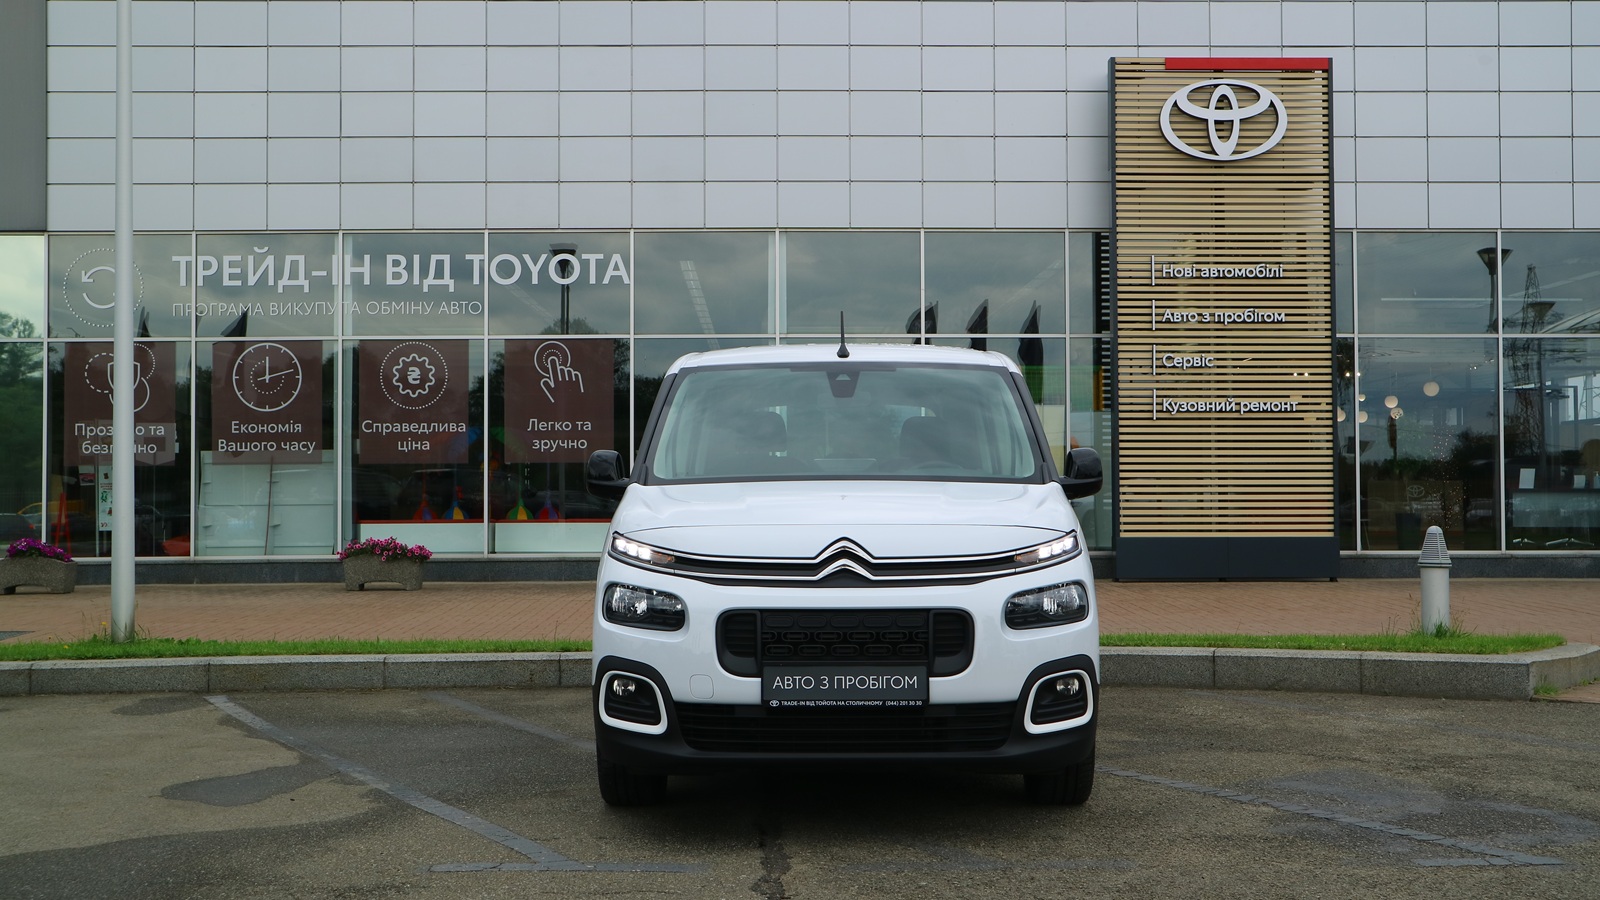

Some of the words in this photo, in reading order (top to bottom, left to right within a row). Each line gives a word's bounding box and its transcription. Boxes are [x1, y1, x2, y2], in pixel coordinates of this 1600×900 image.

[172, 246, 371, 293] ТРЕЙД-ІН
[386, 254, 455, 293] ВІД
[465, 253, 630, 285] TOYOTA
[1162, 264, 1196, 278] Нові
[1200, 264, 1284, 278] автомобілі
[172, 302, 264, 317] ПРОГРАМА
[270, 301, 338, 316] ВИКУПУ
[366, 301, 435, 315] ОБМІНУ
[438, 301, 482, 315] АВТО
[1162, 309, 1198, 323] Авто
[1201, 312, 1210, 323] з
[1214, 308, 1286, 326] пробігом
[1162, 354, 1214, 370] Сервіс
[1162, 398, 1236, 415] Кузовний
[1240, 400, 1299, 415] ремонт
[74, 423, 145, 439] Прозо
[148, 425, 165, 436] та
[231, 420, 302, 434] Економія
[361, 420, 466, 435] Справедлива
[527, 418, 572, 432] Легко
[575, 420, 592, 432] та
[218, 440, 276, 452] Вашого
[281, 441, 316, 454] часу
[398, 438, 430, 452] ціна
[532, 438, 588, 453] зручно
[772, 676, 815, 689] АВТО
[834, 675, 918, 689] ПРОБІГОМ
